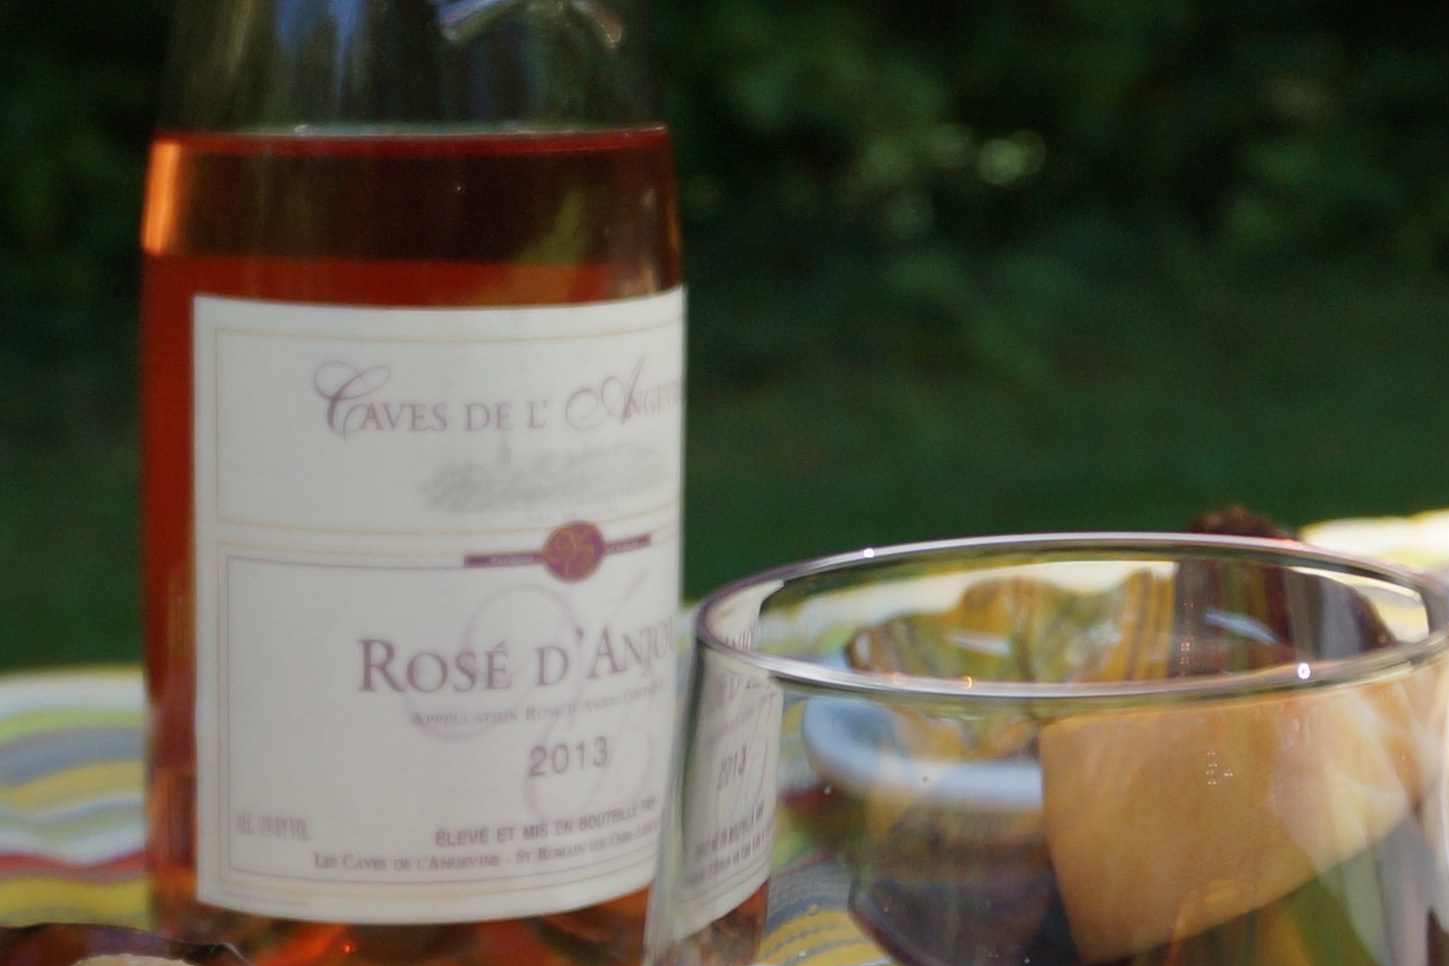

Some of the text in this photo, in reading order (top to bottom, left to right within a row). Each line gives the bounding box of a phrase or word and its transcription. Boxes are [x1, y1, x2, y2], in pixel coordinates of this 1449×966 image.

[312, 360, 448, 443] CAVES
[463, 401, 513, 432] DE
[356, 638, 512, 694] ROSÉ
[528, 736, 609, 778] 2013
[496, 826, 514, 844] ET
[523, 822, 549, 841] MIS
[555, 818, 573, 836] EN
